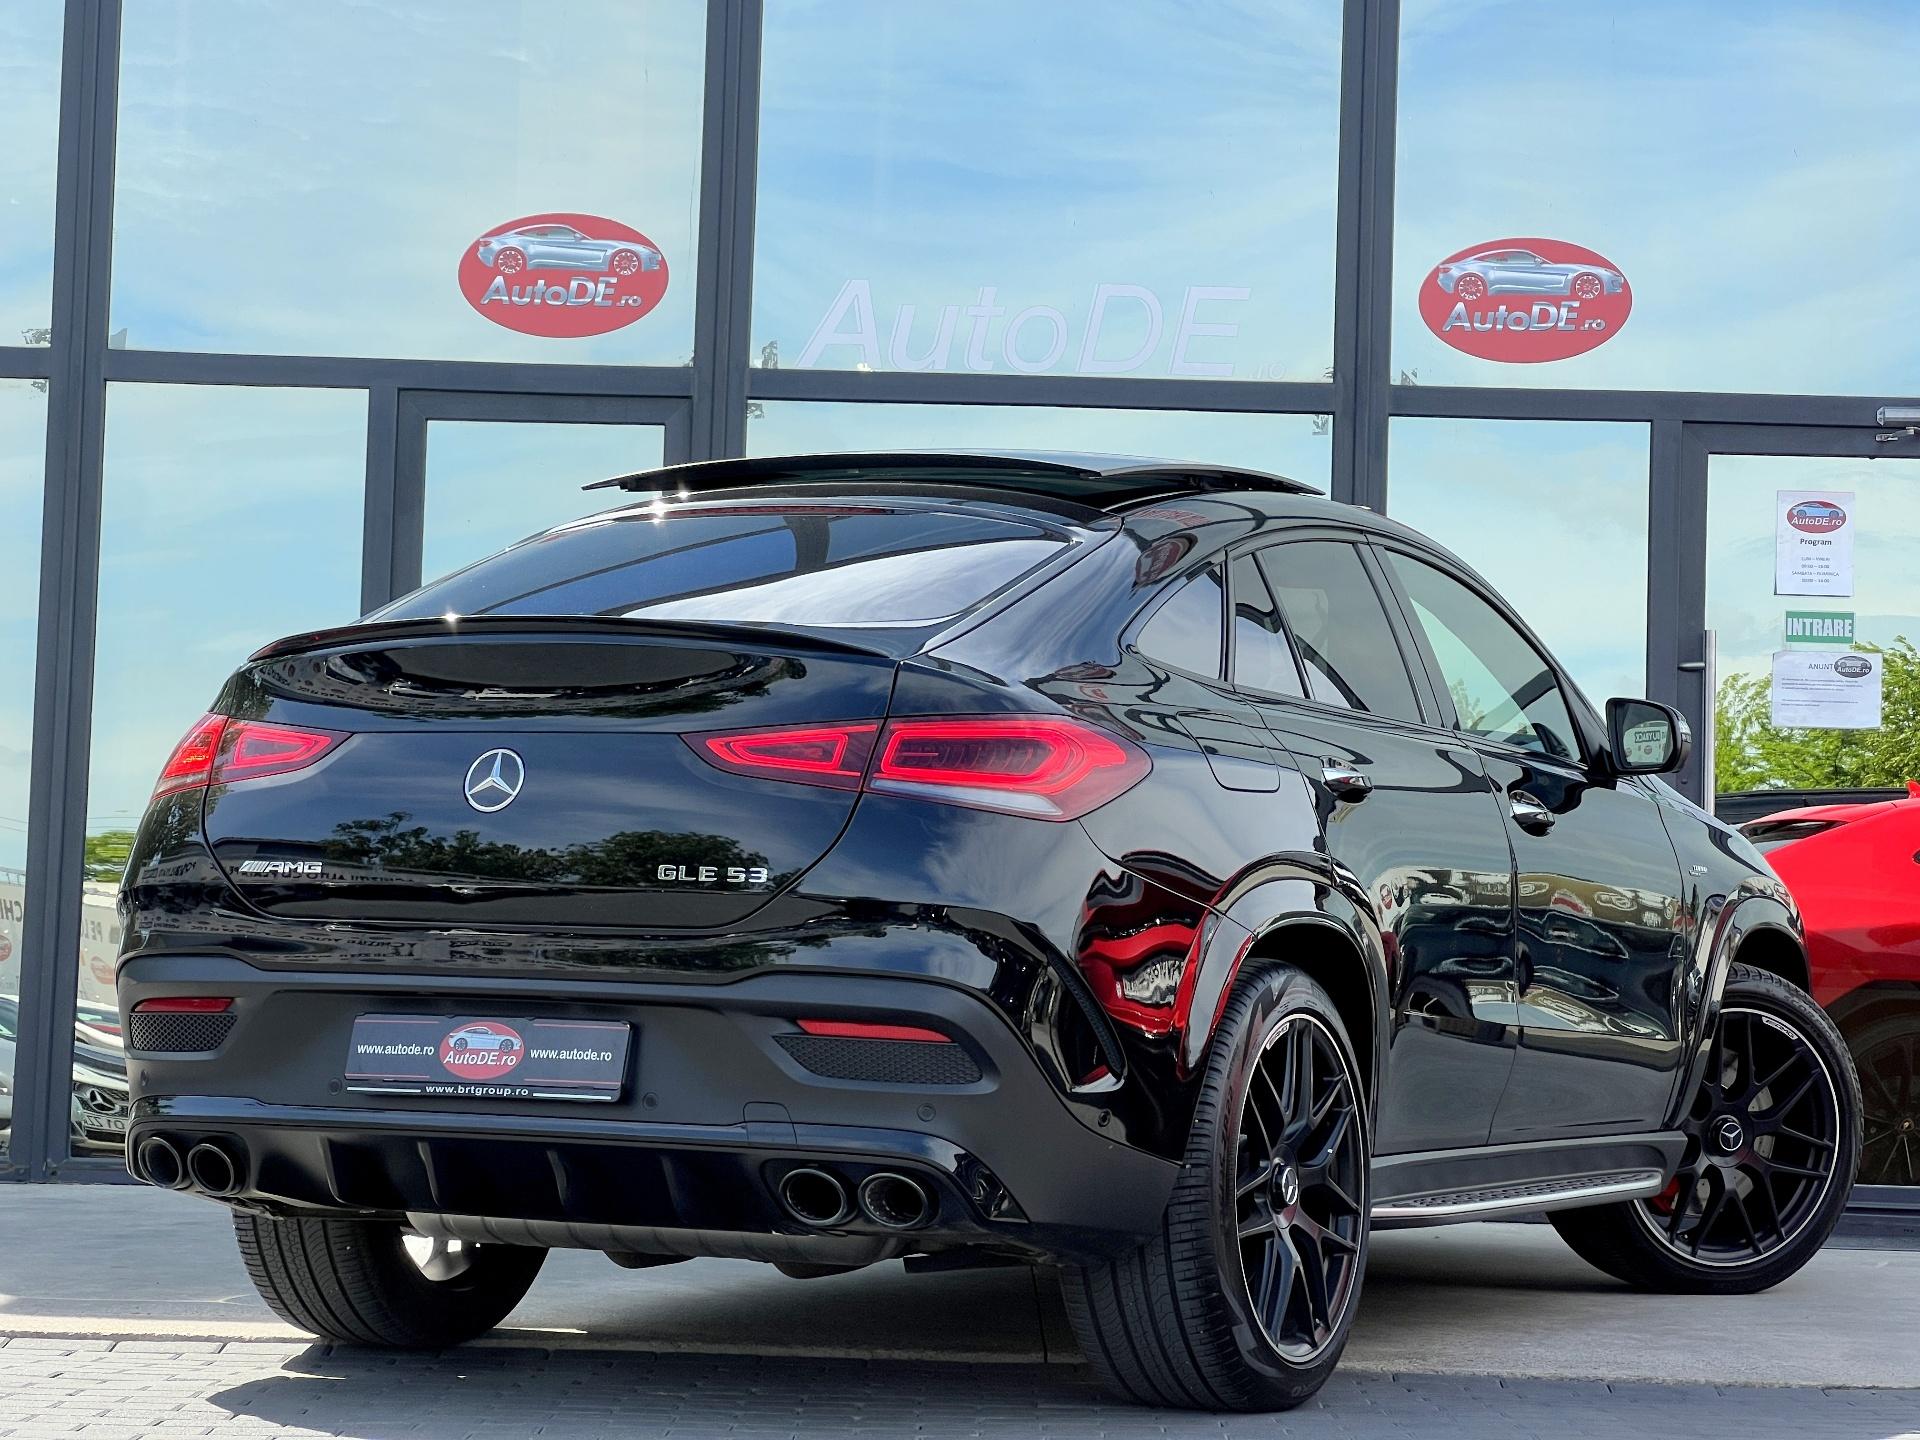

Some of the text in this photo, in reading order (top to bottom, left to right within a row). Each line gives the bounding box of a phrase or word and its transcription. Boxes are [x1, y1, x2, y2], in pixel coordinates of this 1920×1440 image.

[1791, 516, 1843, 526] AutoDE.ro
[1800, 538, 1832, 547] Program
[1787, 617, 1853, 638] INTRARE
[262, 861, 322, 874] AMG
[658, 864, 768, 883] GLE 53
[357, 1042, 435, 1056] www.autode.ro
[530, 1047, 613, 1062] www.autode.ro
[443, 1050, 517, 1067] AutoDE.ro
[425, 1084, 529, 1097] www.brtgroup.ro
